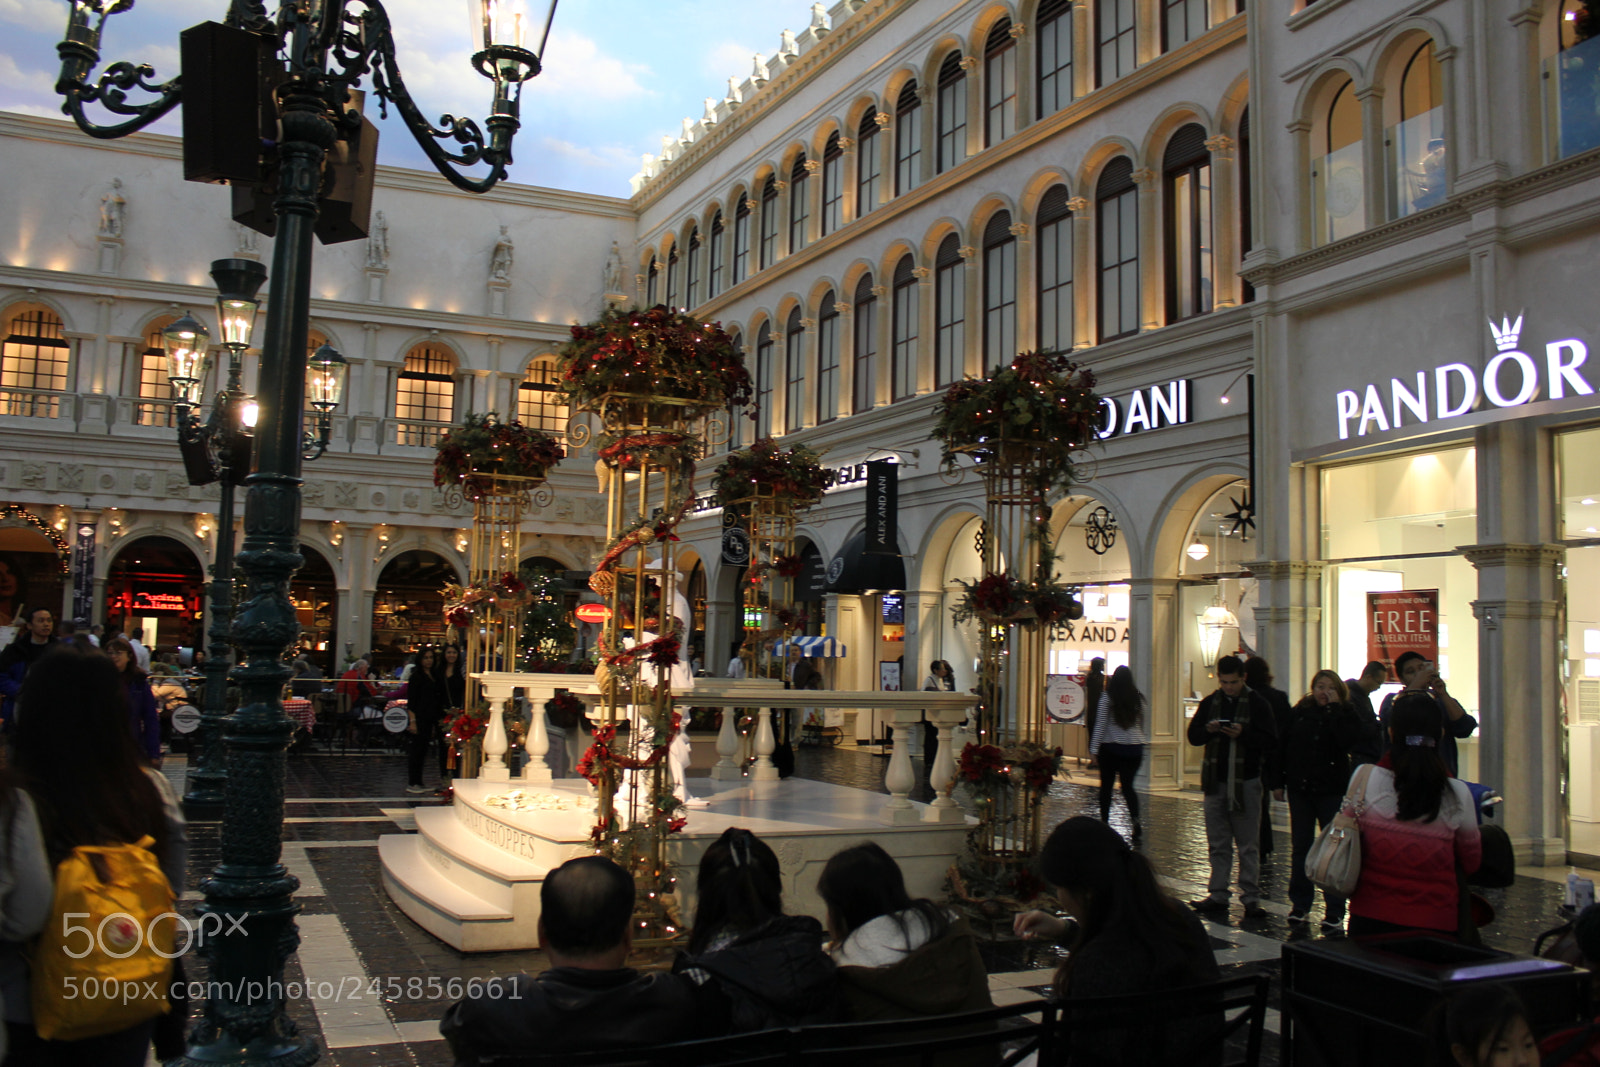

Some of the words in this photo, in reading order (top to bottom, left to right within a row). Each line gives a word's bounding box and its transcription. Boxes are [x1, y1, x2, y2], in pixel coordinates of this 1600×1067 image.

[1336, 338, 1600, 440] PANDOR
[1124, 379, 1188, 434] ANI
[878, 475, 887, 494] ANI
[878, 495, 887, 518] AND
[877, 519, 887, 544] ALEX
[1373, 610, 1431, 633] FREE
[1081, 625, 1117, 643] AND
[1374, 633, 1408, 643] JEWELRY
[1410, 633, 1431, 643] ITEM
[485, 819, 535, 860] SHOPPES
